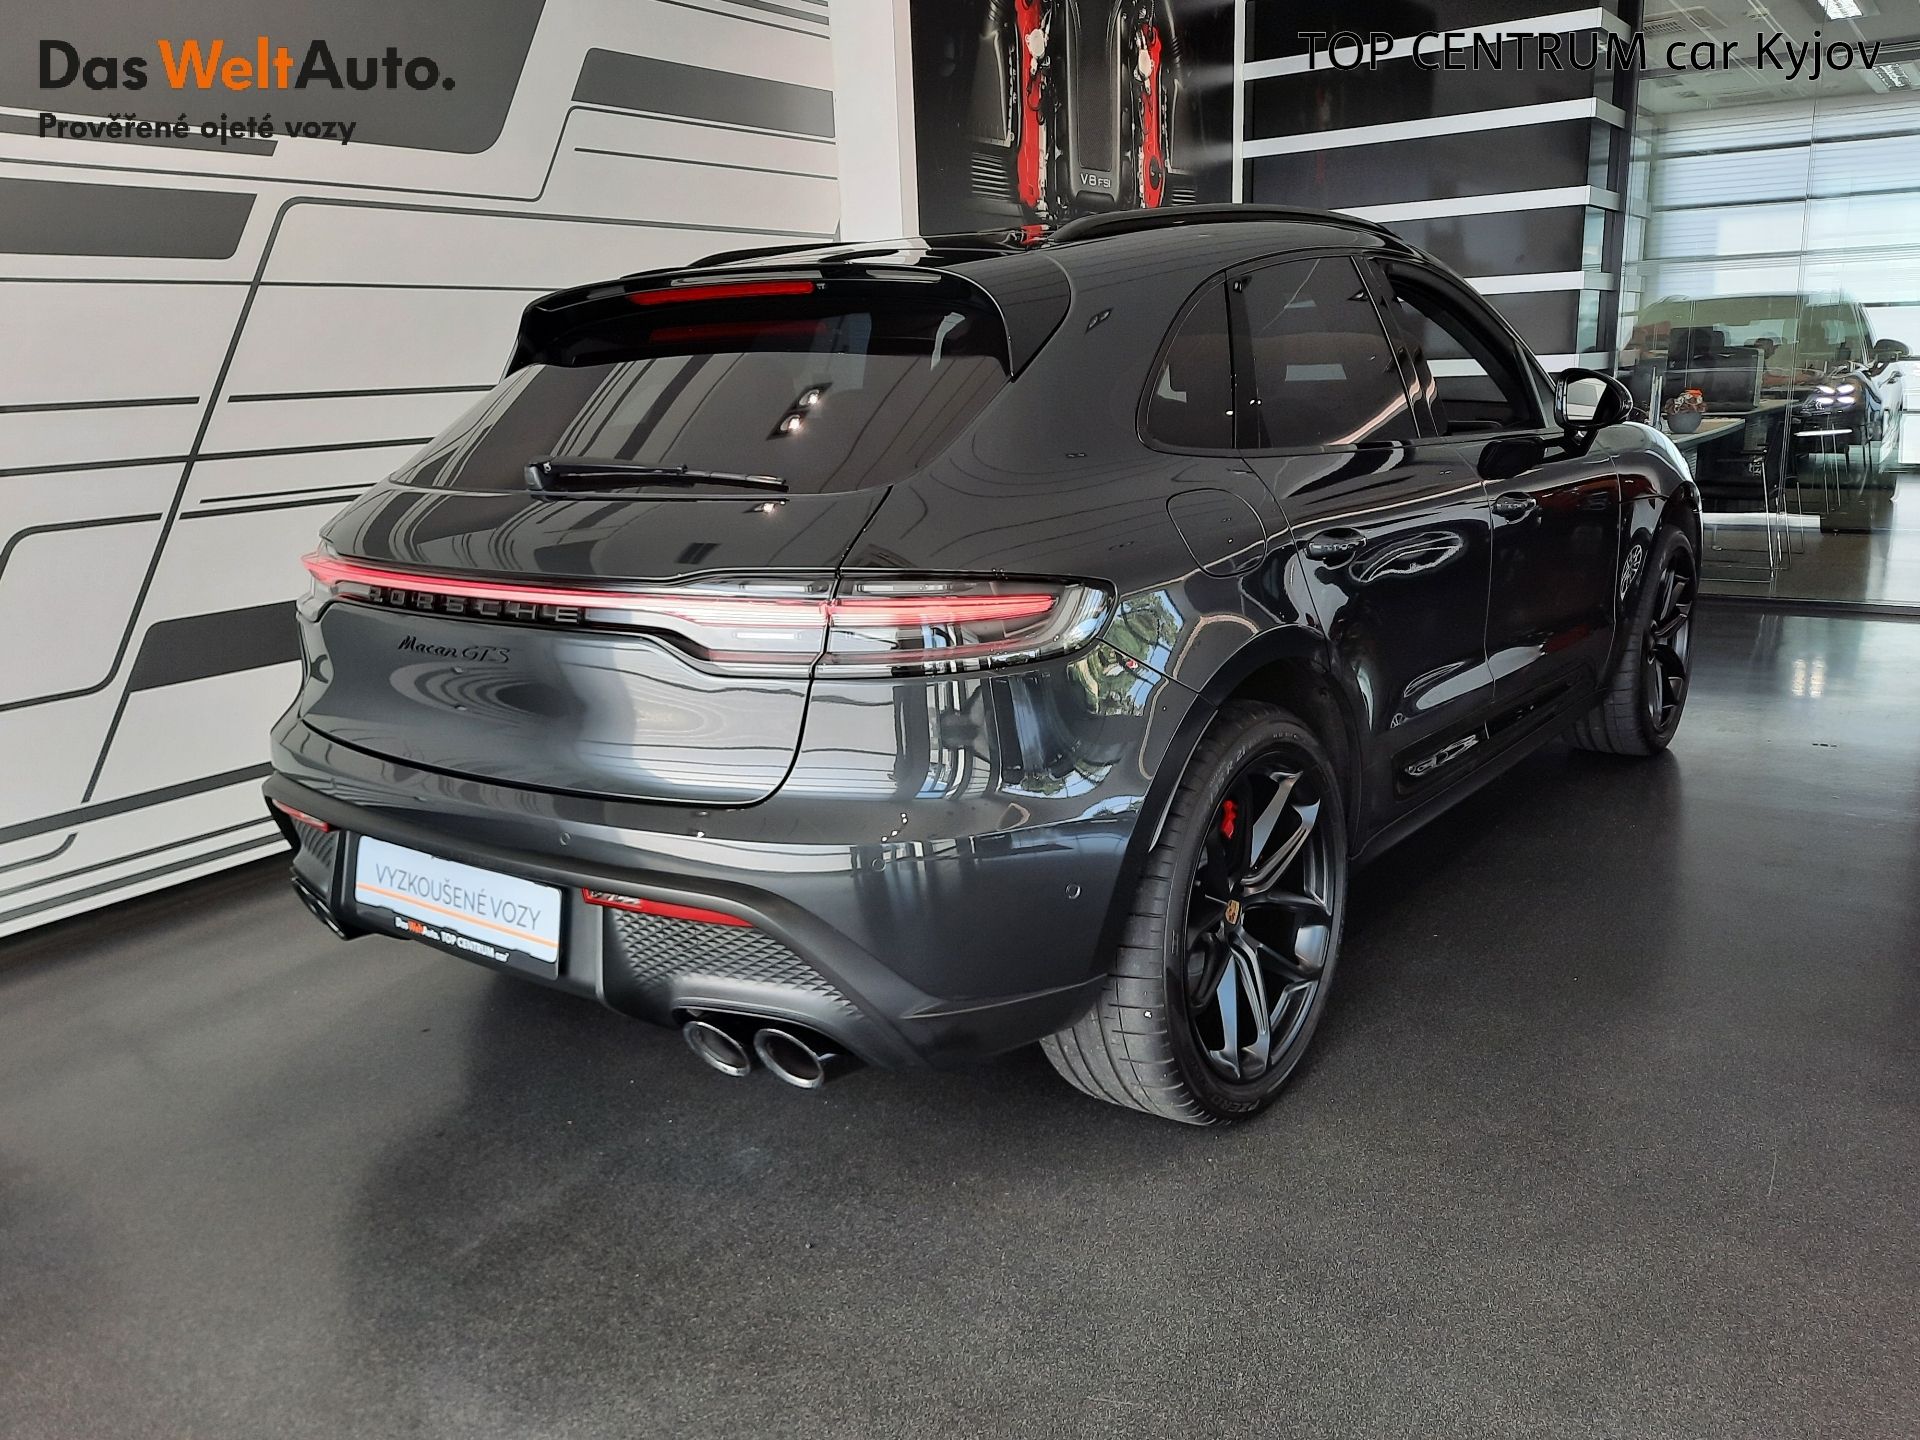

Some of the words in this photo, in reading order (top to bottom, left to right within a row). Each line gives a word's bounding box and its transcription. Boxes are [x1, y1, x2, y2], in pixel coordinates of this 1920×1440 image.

[1080, 173, 1097, 186] V8
[368, 585, 579, 623] PORSCHE
[398, 635, 458, 659] Macan
[462, 645, 511, 663] GTS
[375, 863, 487, 916] VYZKOUŠENÉ
[490, 896, 541, 931] VOZY
[440, 930, 457, 946] TOP
[456, 936, 495, 959] CENTRUM
